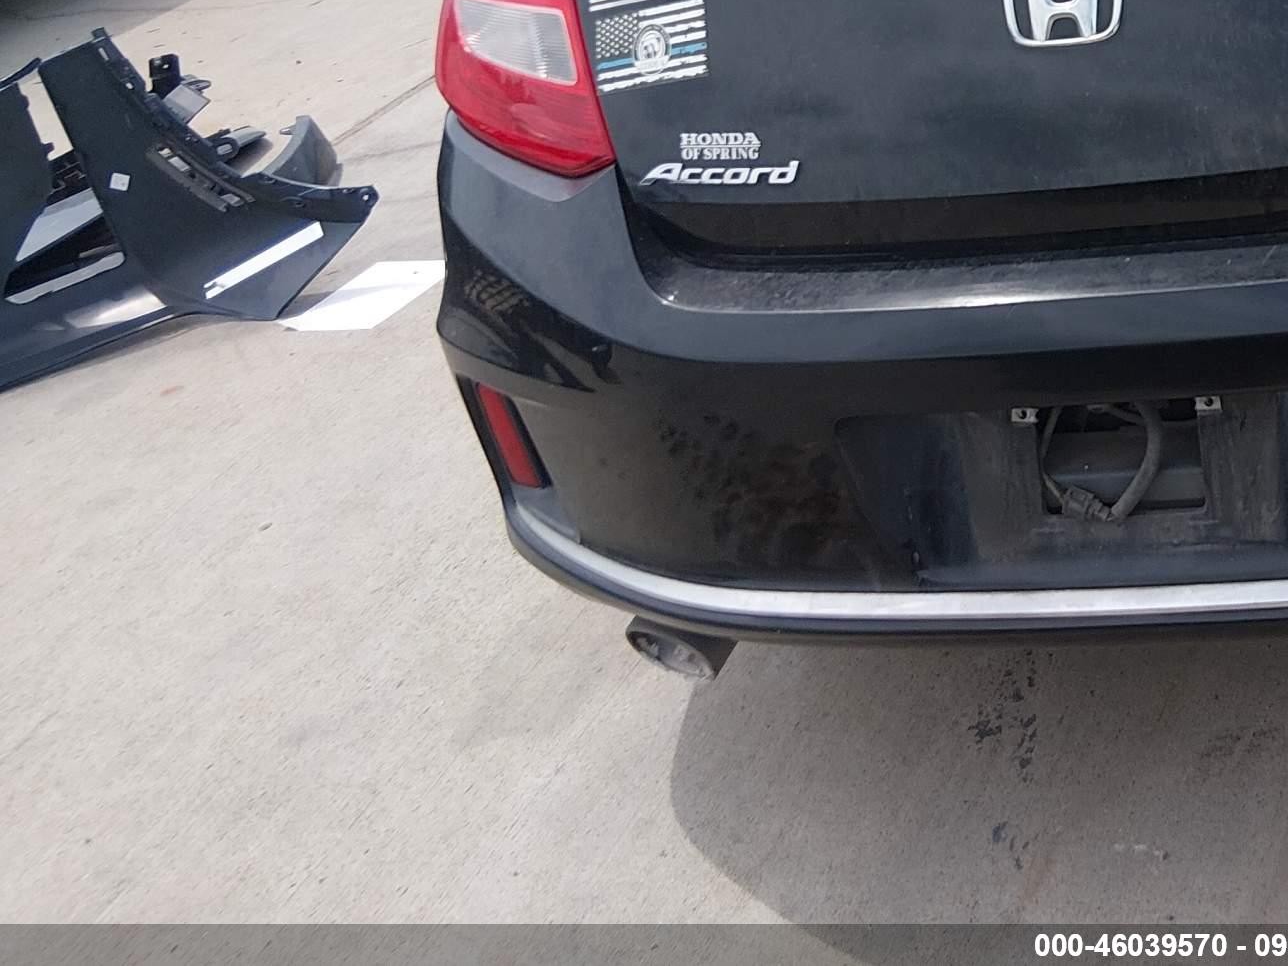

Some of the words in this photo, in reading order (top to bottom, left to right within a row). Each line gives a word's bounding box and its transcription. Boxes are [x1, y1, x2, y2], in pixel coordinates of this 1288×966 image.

[680, 132, 761, 145] HONDA
[681, 148, 701, 161] OF
[703, 147, 760, 160] SPRING
[639, 160, 800, 186] Accord
